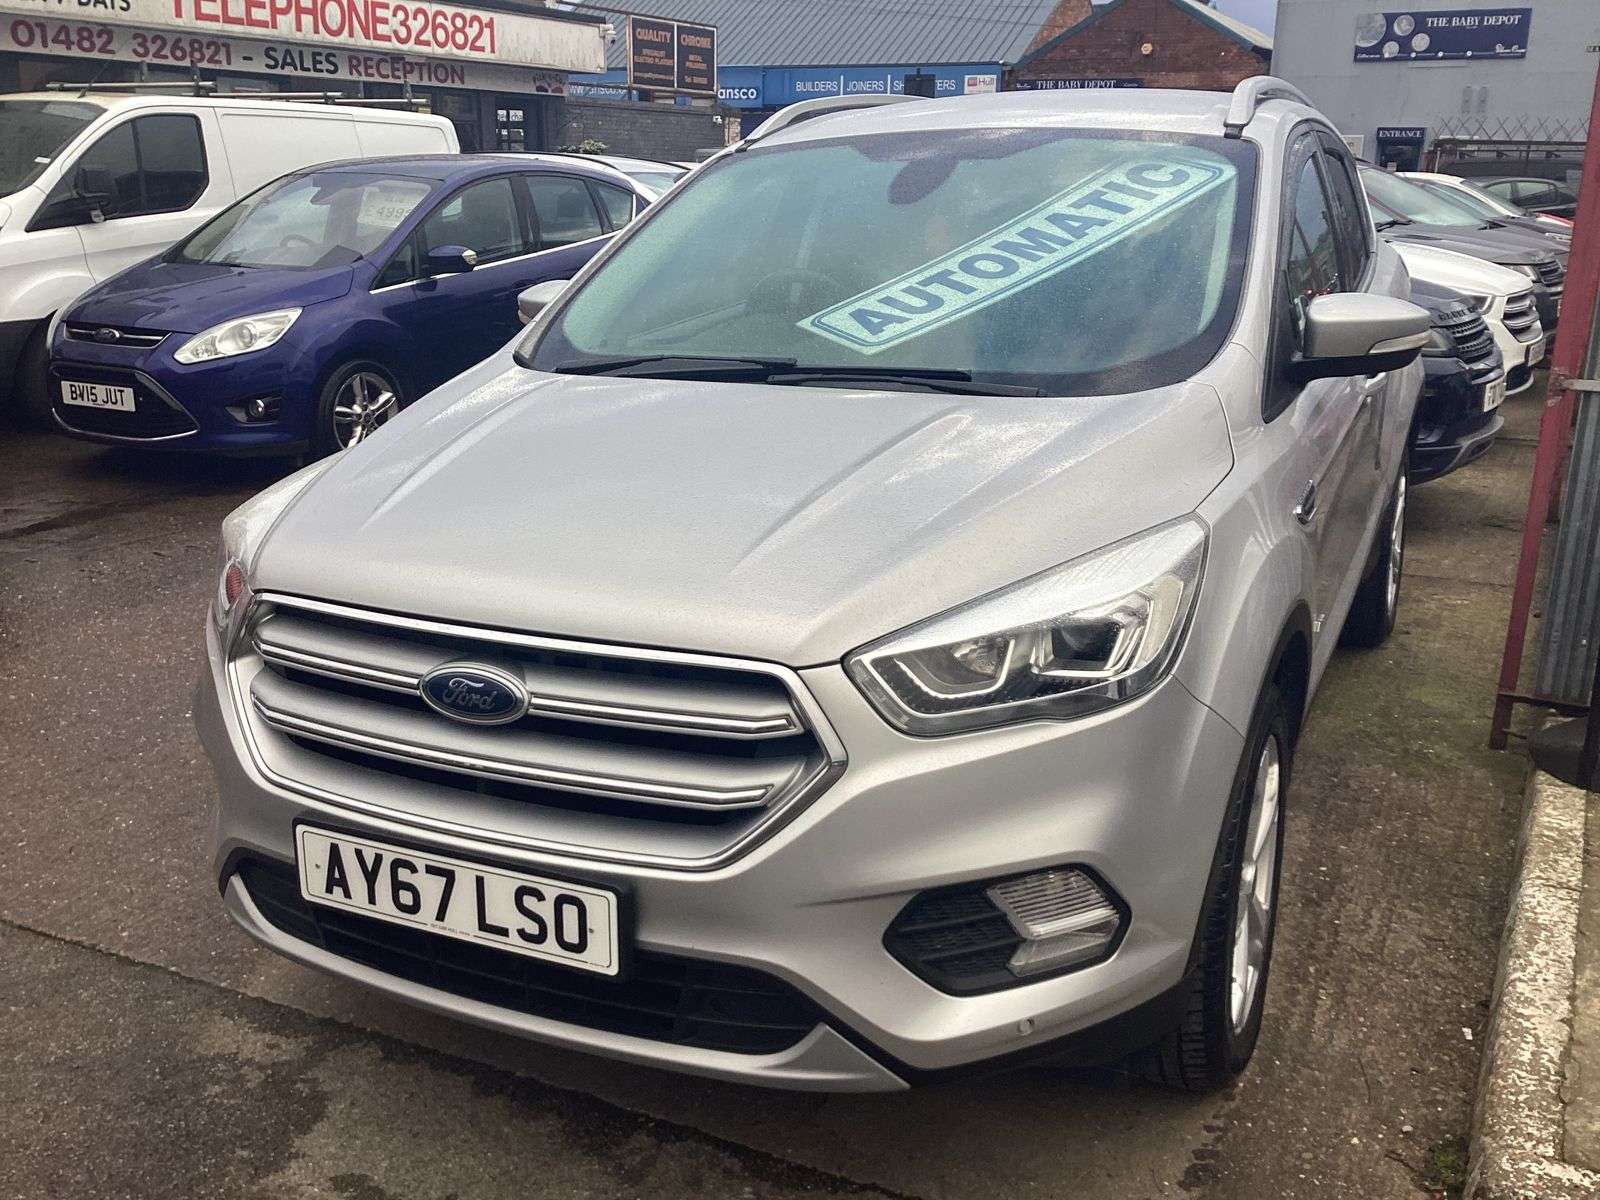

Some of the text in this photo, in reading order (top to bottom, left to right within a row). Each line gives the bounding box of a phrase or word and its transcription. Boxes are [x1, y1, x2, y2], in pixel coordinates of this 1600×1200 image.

[1426, 14, 1523, 27] THE BABY DEPOT
[635, 28, 672, 44] QUALITY
[10, 19, 116, 55] 01482
[131, 32, 232, 66] 326821
[263, 46, 339, 75] SALES
[349, 54, 466, 85] RECEPTION
[796, 81, 839, 92] BUILDERS
[847, 80, 884, 91] JOINERS
[1036, 80, 1055, 89] THE
[1058, 80, 1081, 89] BABY
[1085, 79, 1117, 89] DEPOT
[1379, 125, 1422, 138] ENTRANCE
[848, 161, 1191, 336] AUTOMATIC
[70, 383, 125, 406] BV15 JUT
[442, 677, 498, 710] Ford
[324, 842, 588, 954] AY67 LSO
